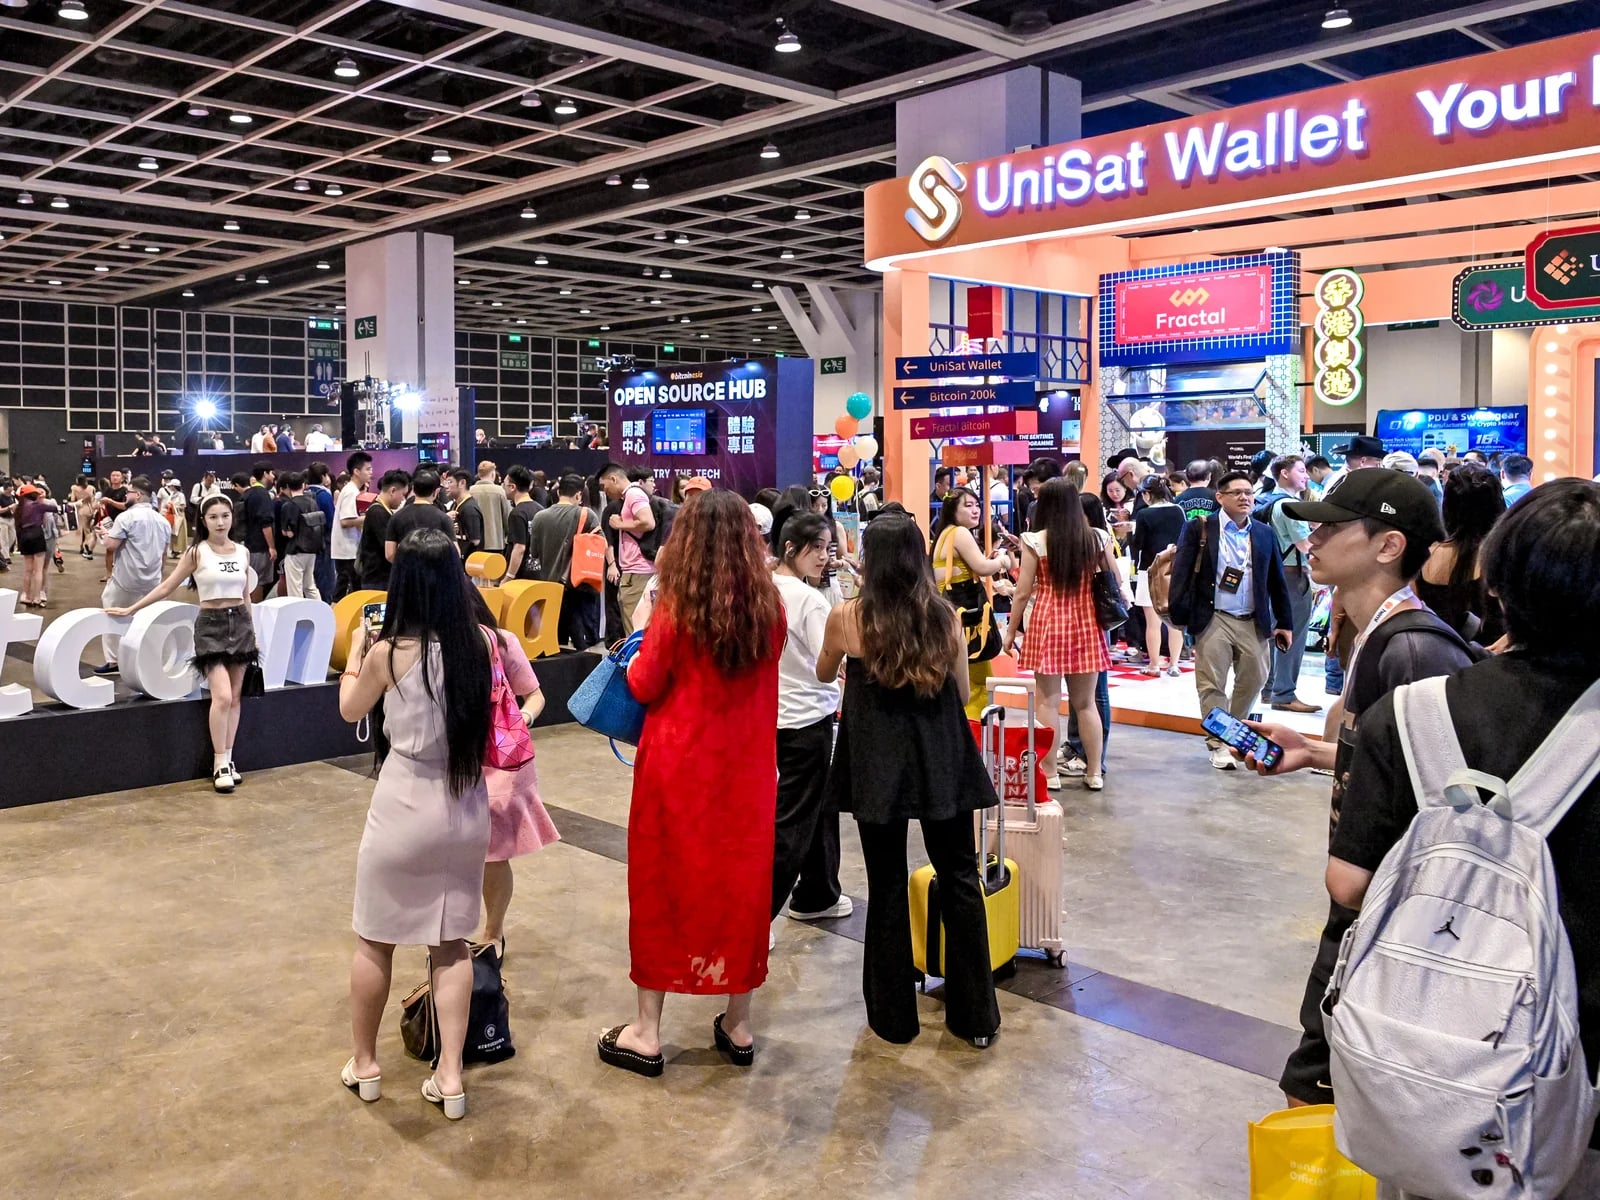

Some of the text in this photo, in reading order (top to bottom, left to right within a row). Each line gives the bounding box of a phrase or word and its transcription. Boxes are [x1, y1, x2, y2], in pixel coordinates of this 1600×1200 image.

[976, 141, 1146, 213] UniSat
[1164, 99, 1367, 182] Wallet
[1416, 70, 1576, 137] Your
[1156, 308, 1226, 329] Fractal
[929, 358, 1002, 372] UniSat Wallet
[614, 380, 767, 405] OPEN SOURCE HUB
[929, 389, 996, 402] Bitcoin 200k
[1428, 413, 1449, 421] PDU
[1451, 413, 1459, 421] &
[932, 420, 991, 433] Fractal Bitcoin
[622, 438, 646, 456] 中心
[653, 468, 720, 479] TRY THE TECH
